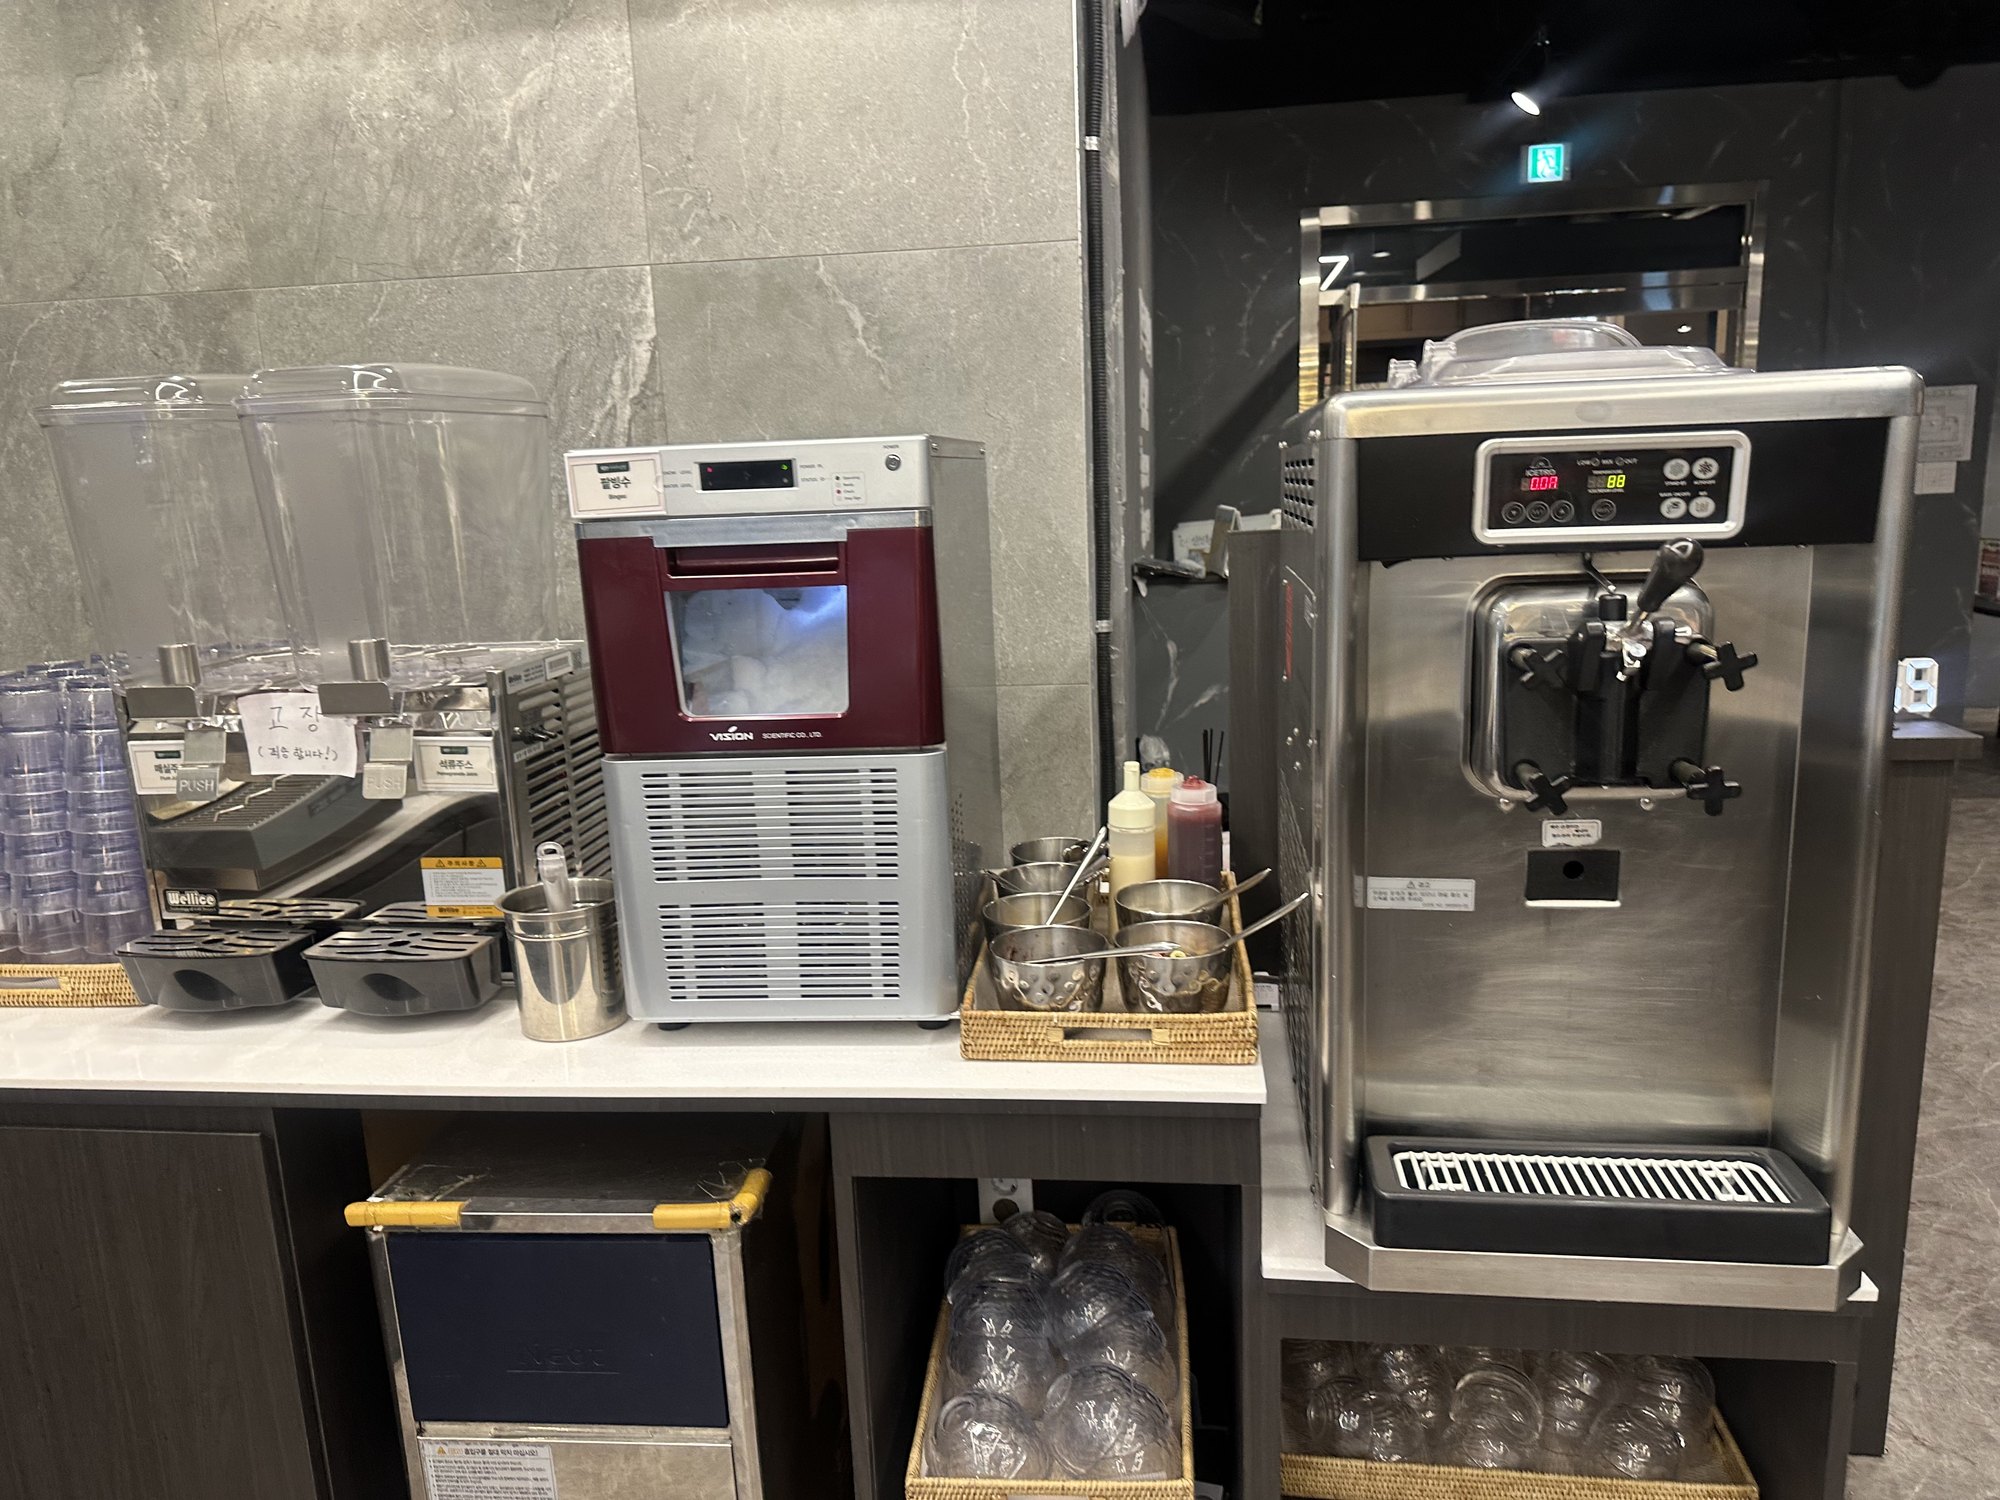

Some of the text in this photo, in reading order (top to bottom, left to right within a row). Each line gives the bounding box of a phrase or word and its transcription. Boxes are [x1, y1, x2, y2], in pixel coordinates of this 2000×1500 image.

[600, 476, 631, 490] 팥빙수
[1606, 474, 1626, 489] 88
[709, 731, 754, 741] VISION
[154, 763, 178, 774] 매실주
[439, 759, 474, 770] 석류주스
[180, 779, 214, 792] PUSH
[367, 776, 402, 790] PUSH
[167, 891, 215, 905] Wellice
